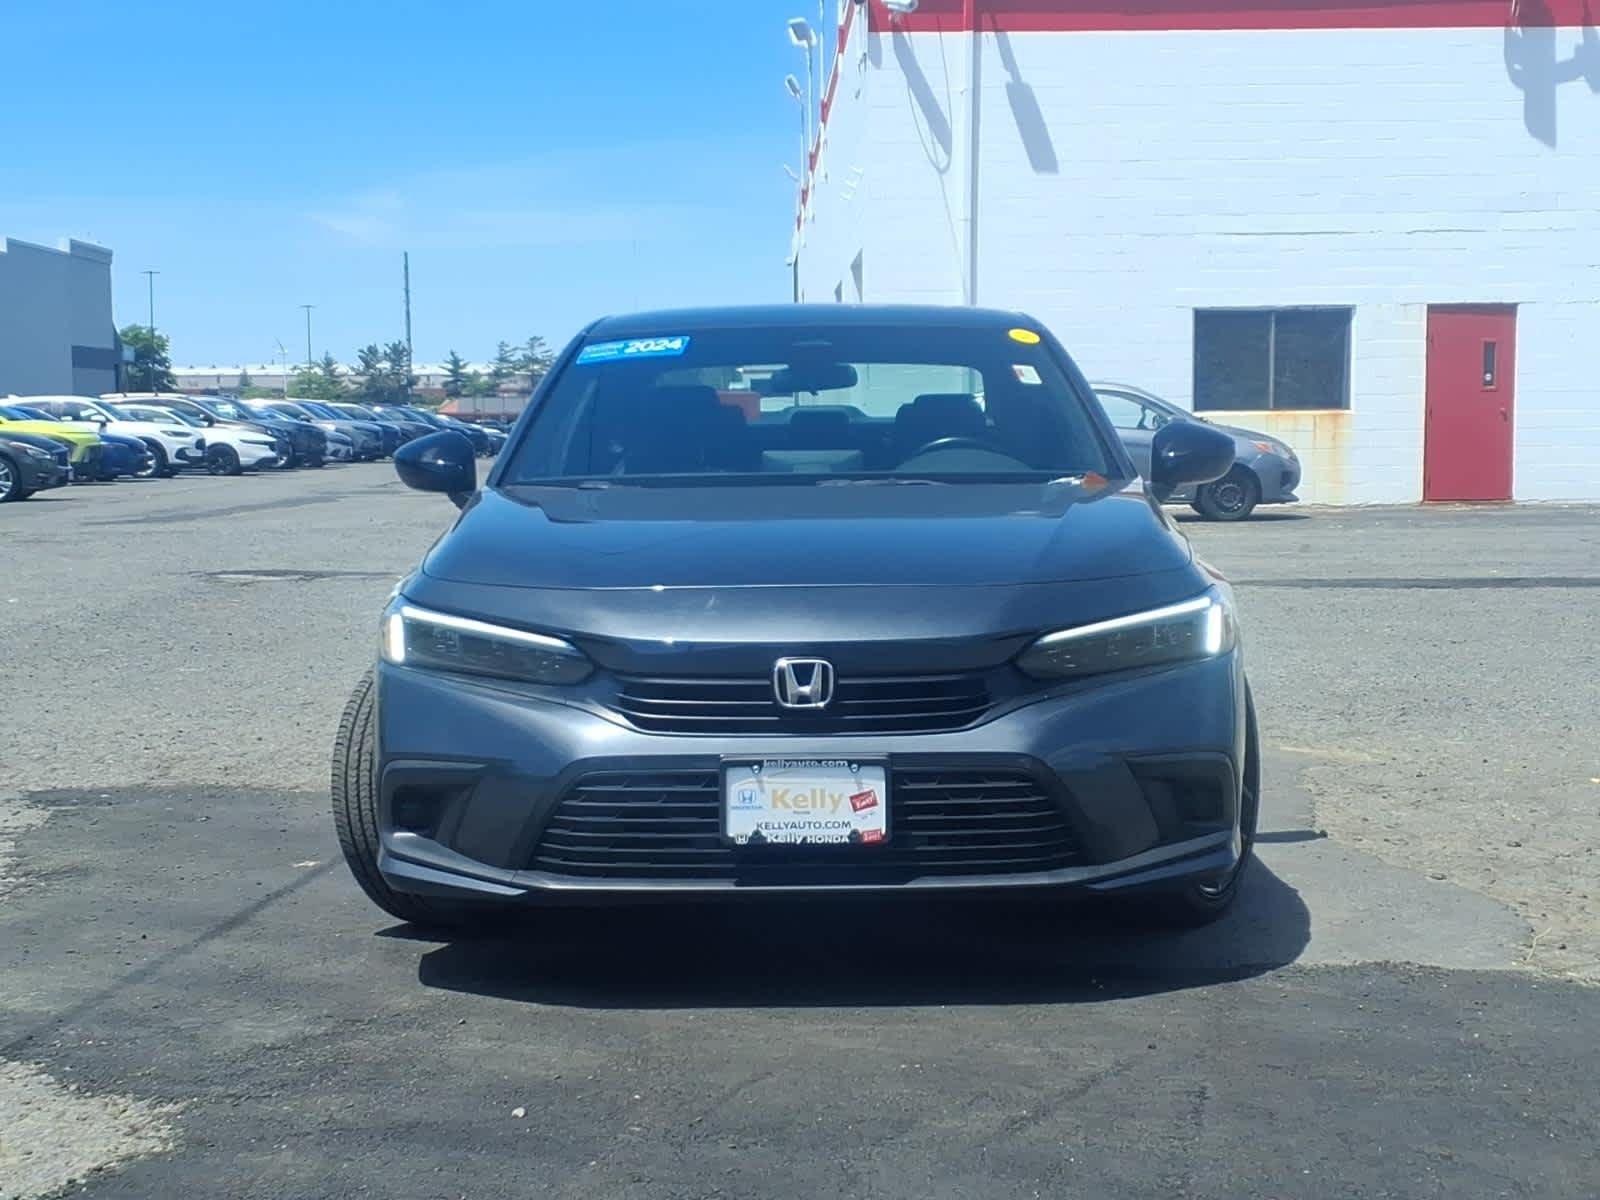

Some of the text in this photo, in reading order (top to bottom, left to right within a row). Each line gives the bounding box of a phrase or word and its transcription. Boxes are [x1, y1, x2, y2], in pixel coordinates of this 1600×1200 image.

[623, 337, 683, 353] 2024
[771, 788, 843, 815] Kelly
[756, 821, 852, 831] KELLYAUTO.COM
[767, 832, 806, 844] Kelly
[807, 834, 850, 844] HONDA
